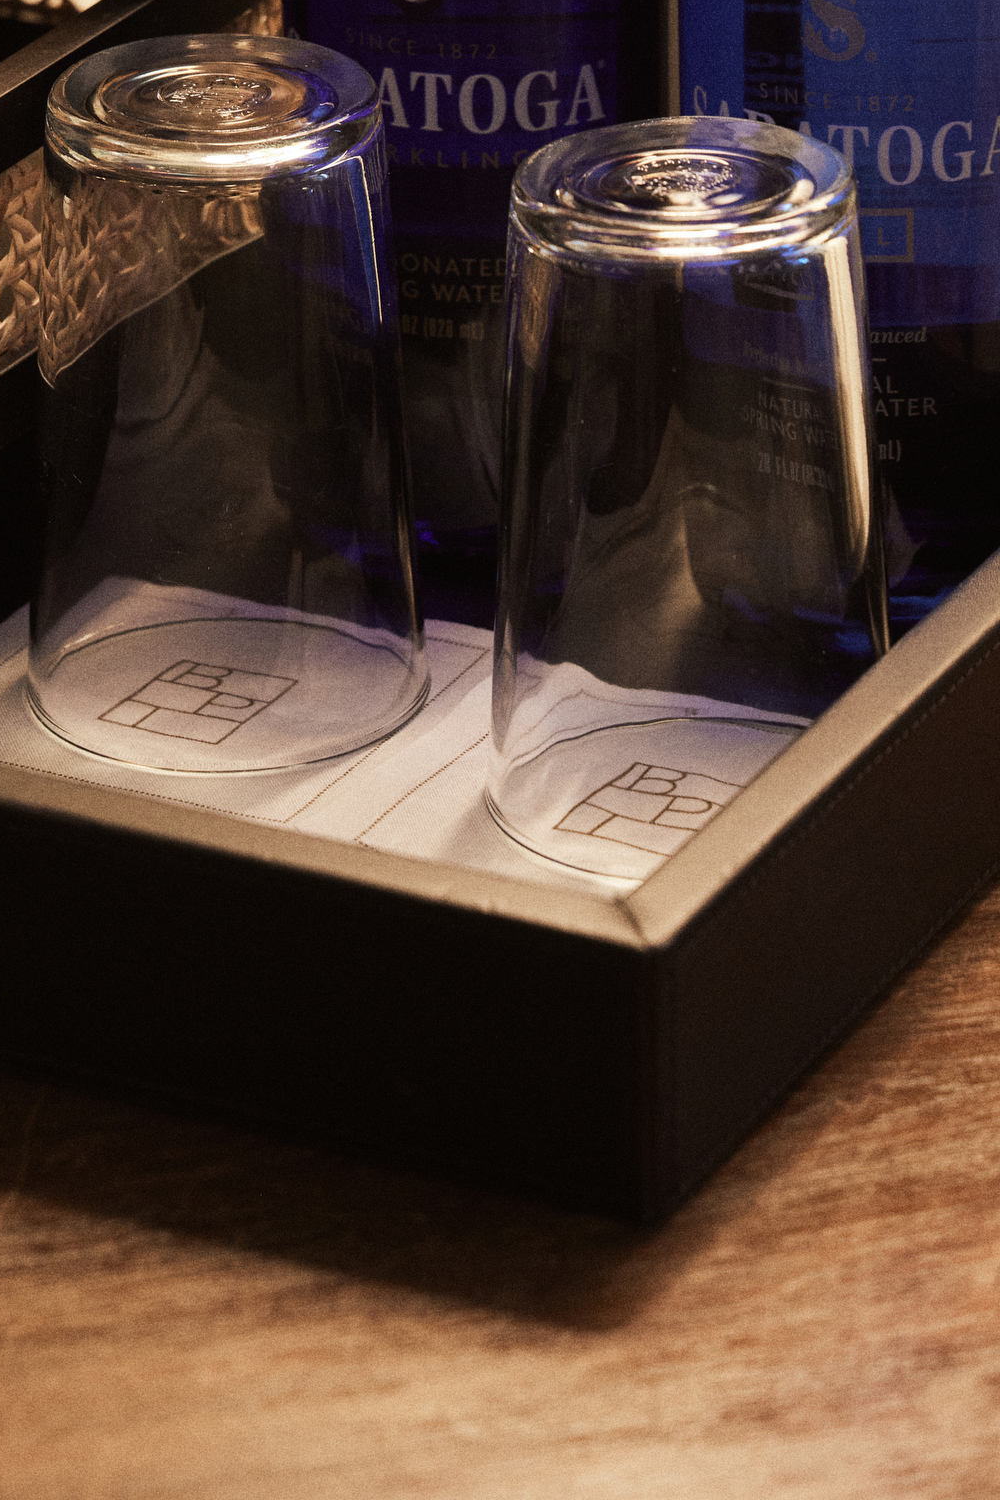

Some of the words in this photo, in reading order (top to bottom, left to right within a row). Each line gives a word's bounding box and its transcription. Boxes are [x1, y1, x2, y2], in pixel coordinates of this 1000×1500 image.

[344, 26, 417, 56] SINCE
[437, 42, 498, 61] 1872
[758, 82, 835, 110] SINCE
[855, 94, 915, 113] 1872
